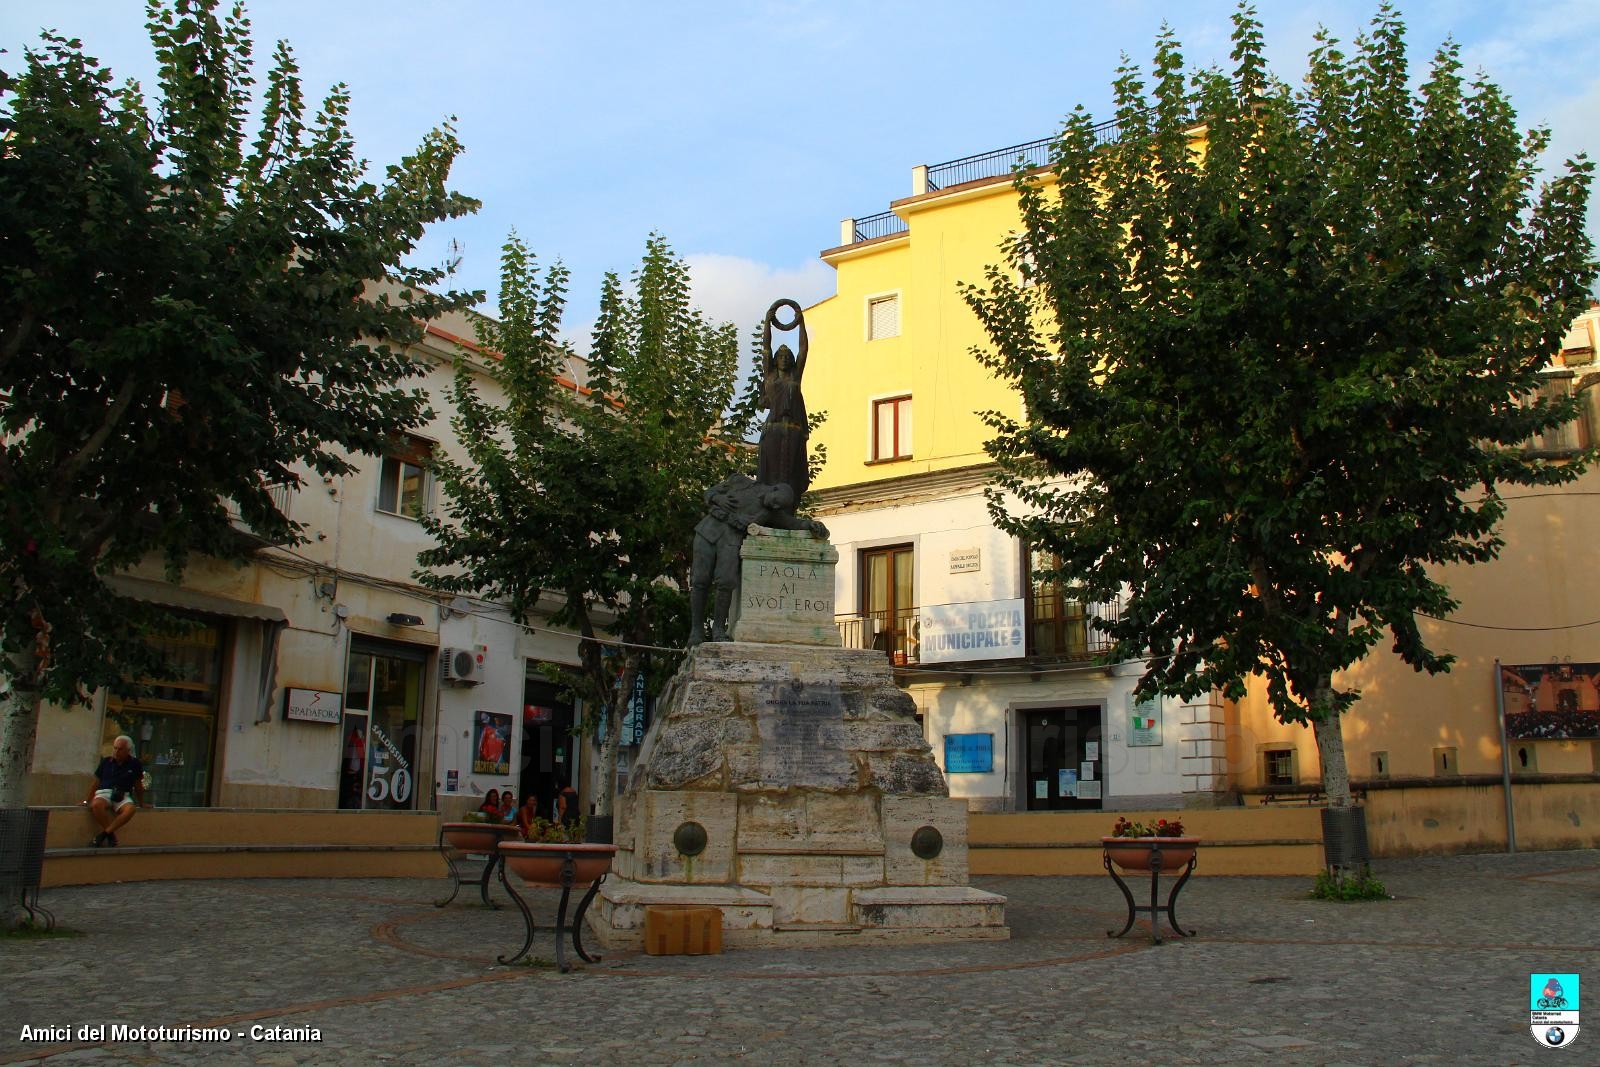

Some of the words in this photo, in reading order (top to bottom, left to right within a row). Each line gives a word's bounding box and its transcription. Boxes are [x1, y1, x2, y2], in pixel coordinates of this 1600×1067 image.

[760, 565, 816, 580] PAOLA
[780, 582, 795, 594] AI
[795, 599, 829, 612] EROI
[968, 610, 1022, 629] POLIZIA
[925, 630, 1009, 652] MUNICIPALE
[291, 706, 340, 719] SPADAFORA
[368, 766, 412, 803] 50
